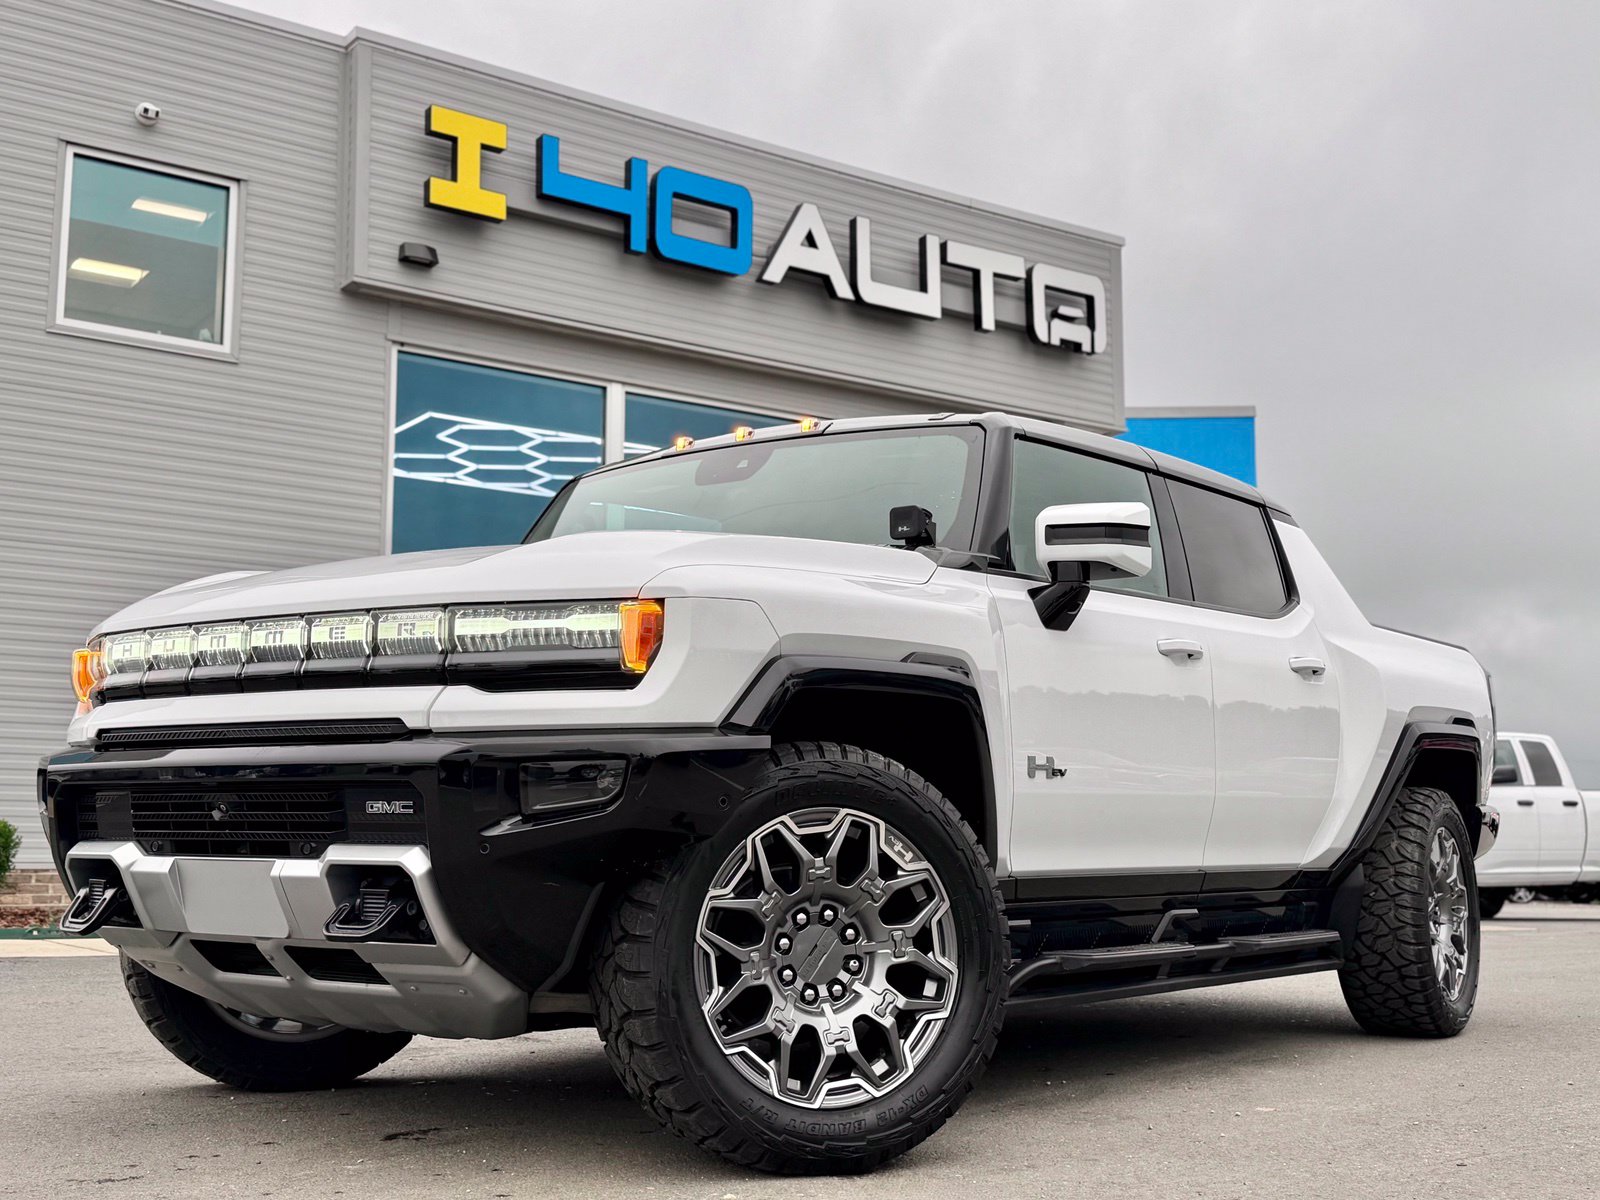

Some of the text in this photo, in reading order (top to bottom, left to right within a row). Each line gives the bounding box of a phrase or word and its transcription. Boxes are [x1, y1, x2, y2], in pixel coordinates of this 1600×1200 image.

[425, 105, 1107, 354] I 40 AUTO
[365, 800, 414, 814] GMC
[784, 1118, 867, 1137] BANDIT
